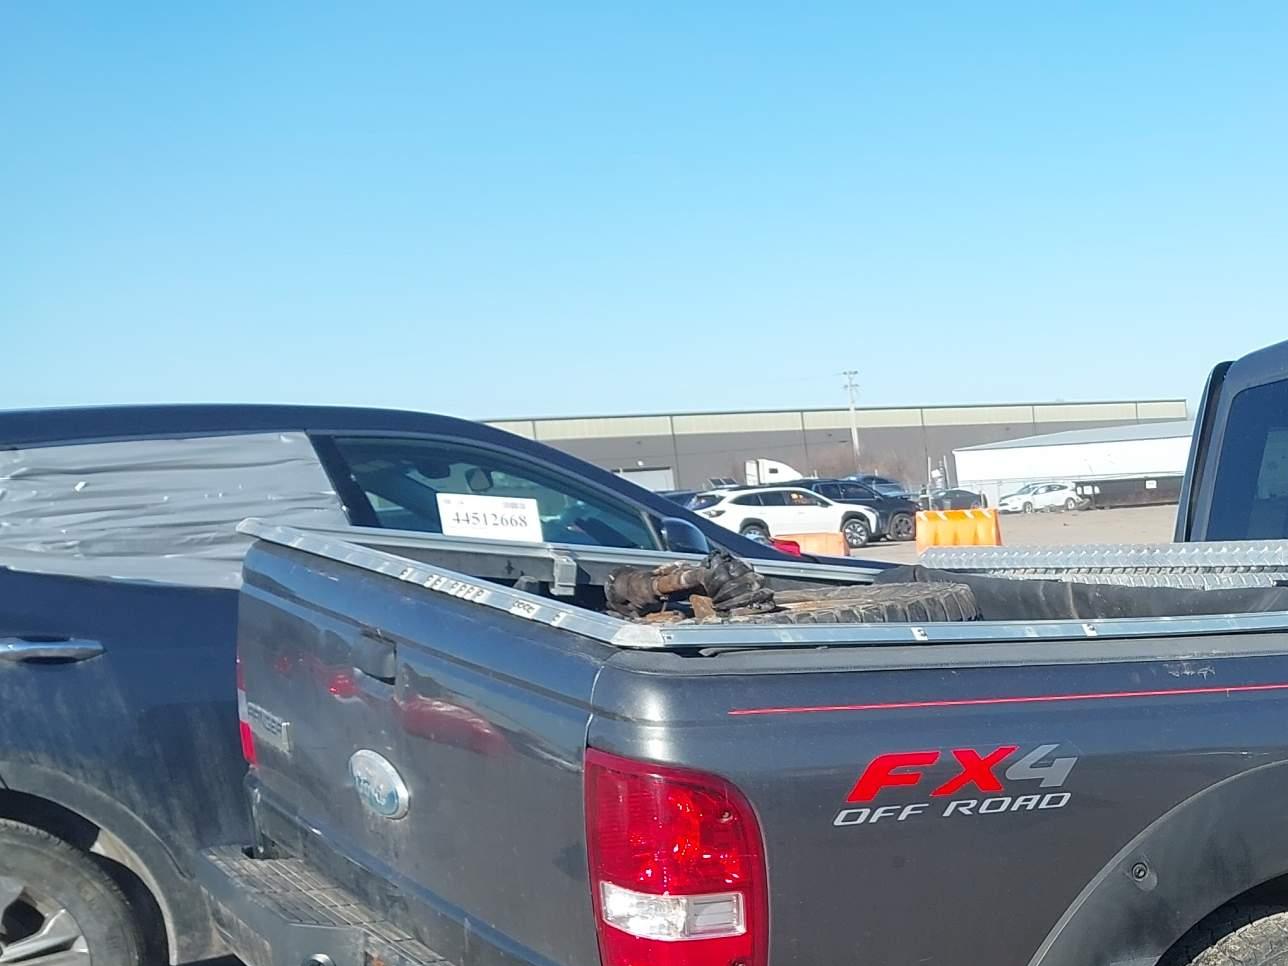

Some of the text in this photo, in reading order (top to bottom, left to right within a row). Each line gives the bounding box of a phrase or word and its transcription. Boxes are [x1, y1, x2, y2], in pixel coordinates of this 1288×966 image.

[452, 511, 528, 528] 44512668
[846, 743, 1079, 803] FX4
[833, 792, 1072, 826] OFF ROAD
